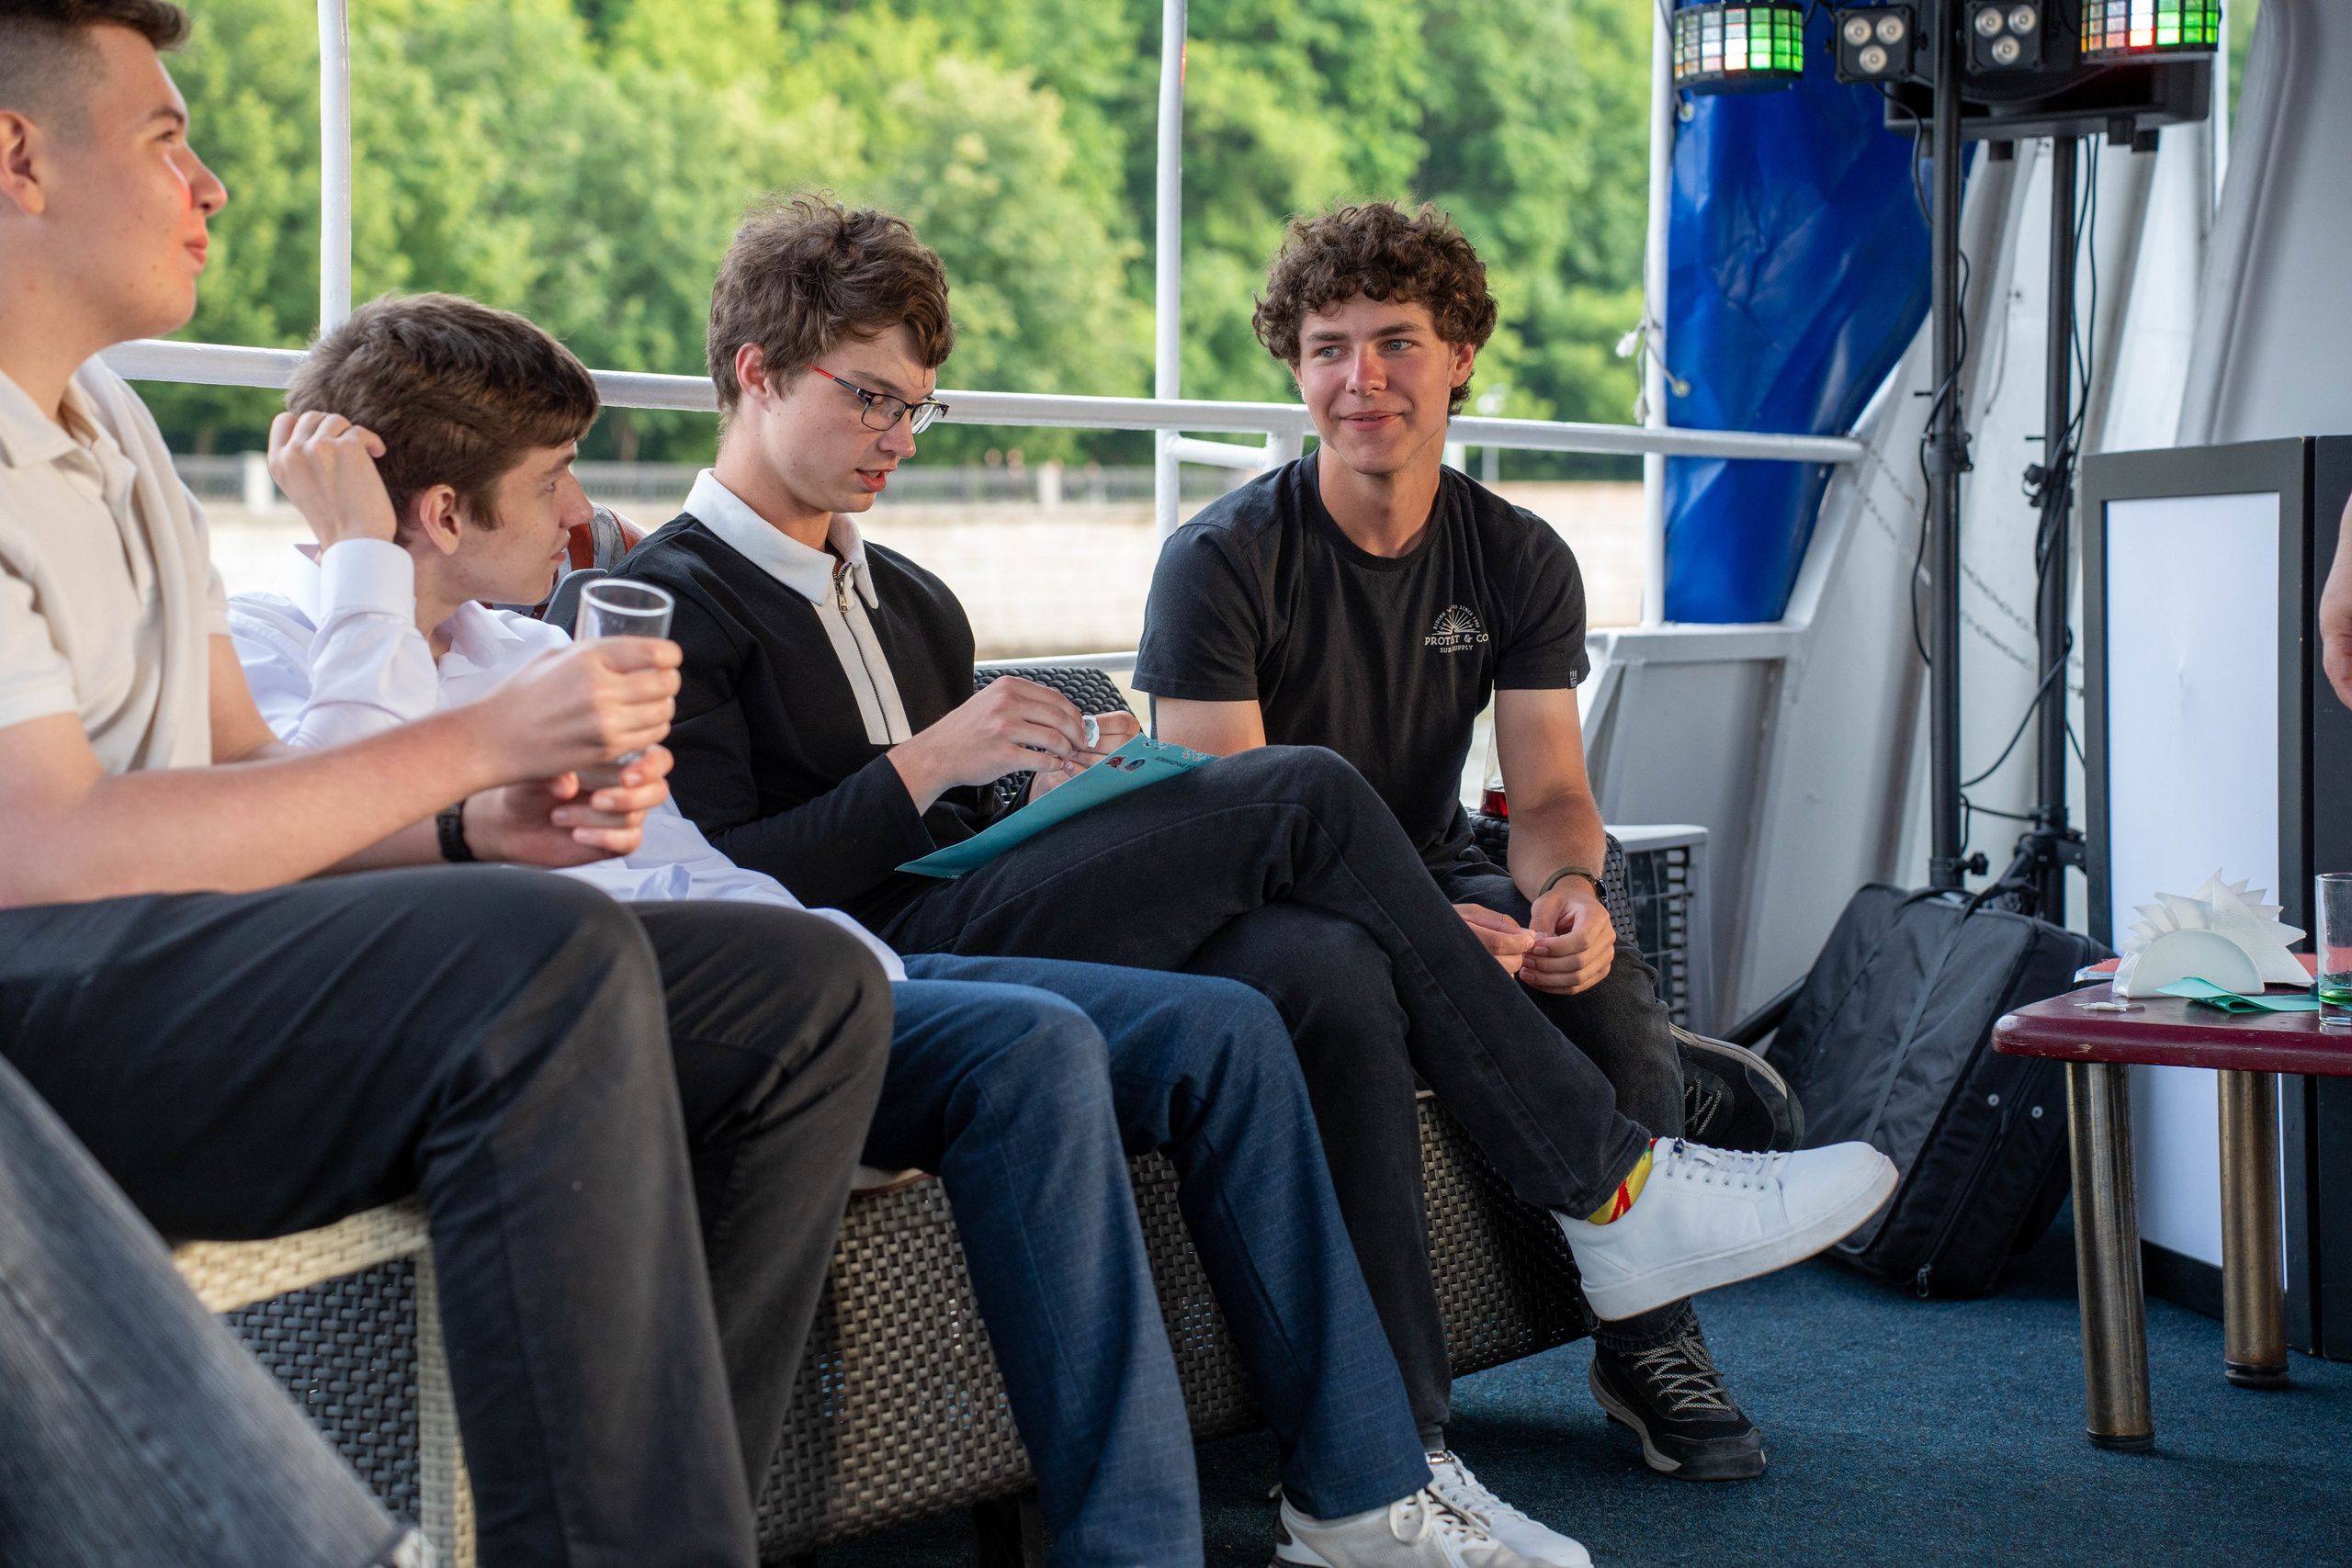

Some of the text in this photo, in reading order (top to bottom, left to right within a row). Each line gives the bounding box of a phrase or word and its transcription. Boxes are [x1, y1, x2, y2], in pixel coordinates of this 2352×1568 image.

[1425, 634, 1488, 645] PROTST & CO
